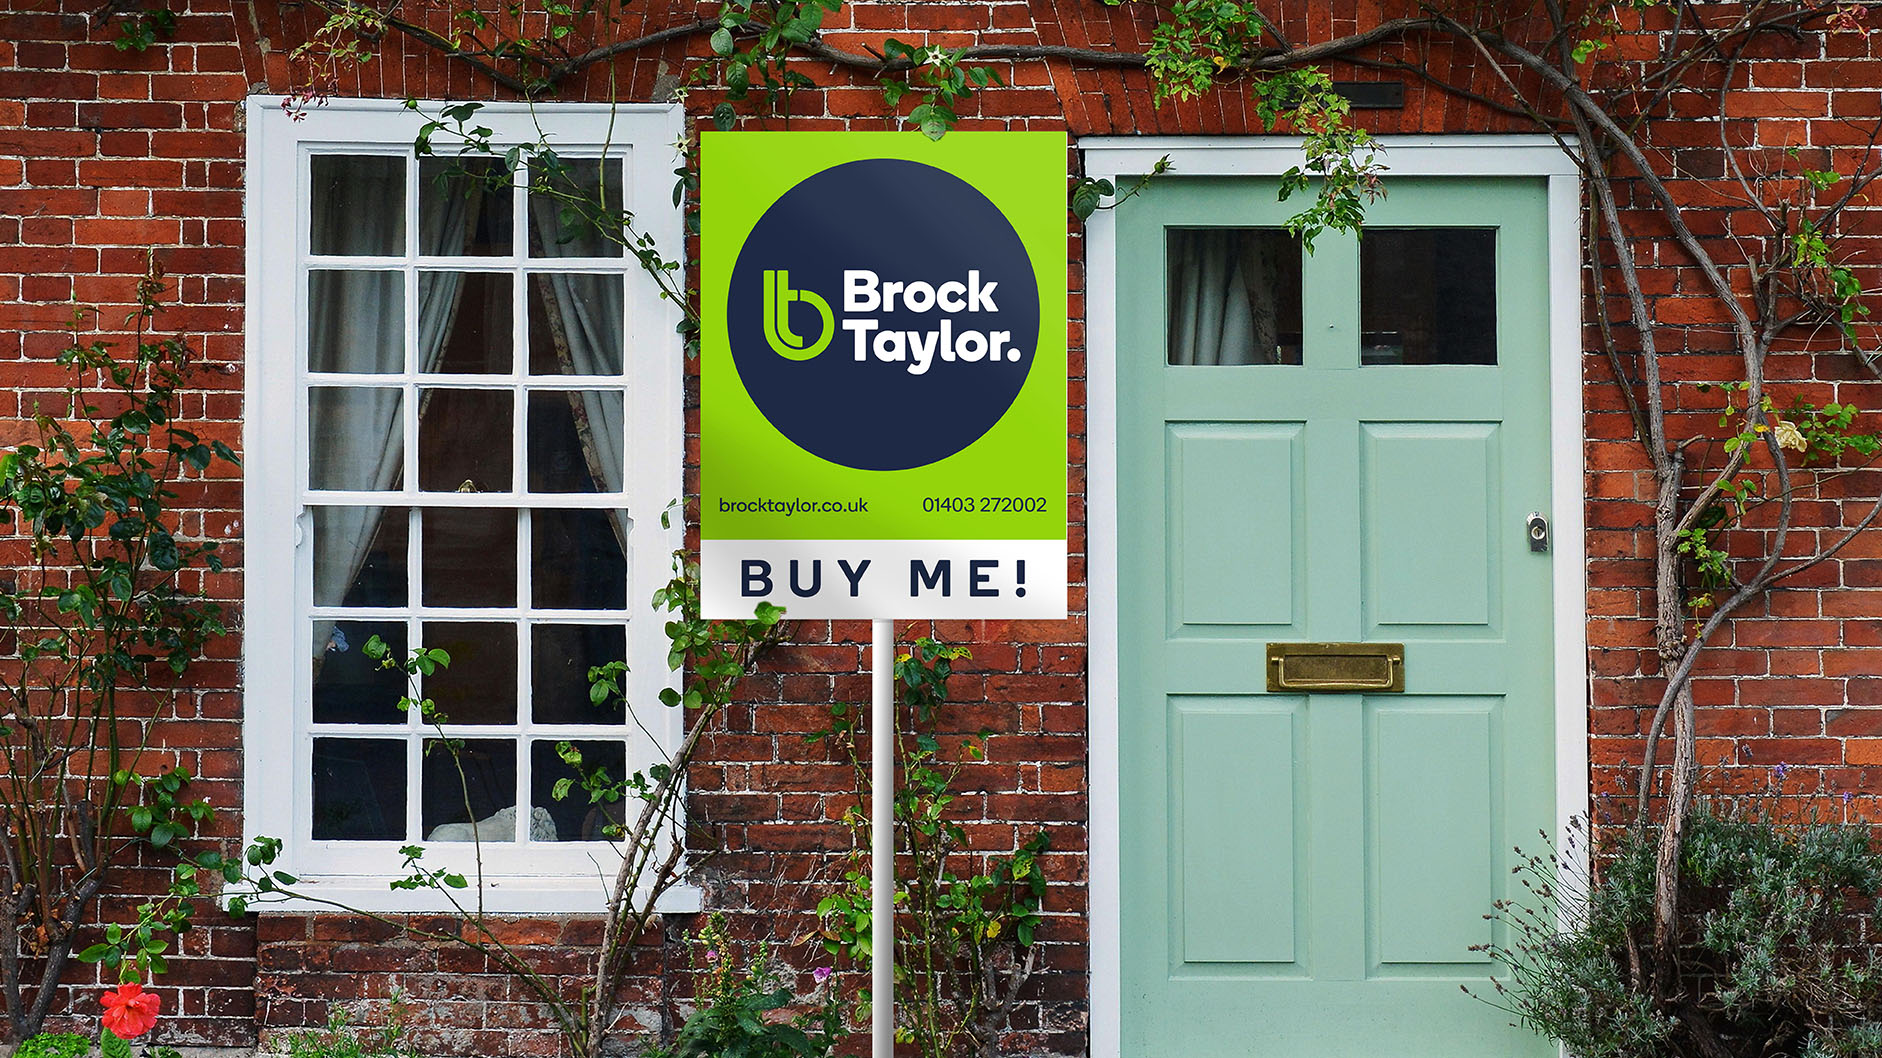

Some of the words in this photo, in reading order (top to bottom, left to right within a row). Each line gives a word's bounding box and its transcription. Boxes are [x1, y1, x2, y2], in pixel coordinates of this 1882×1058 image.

[843, 269, 998, 313] Brock
[842, 318, 1021, 375] Taylor.
[719, 497, 869, 517] brocktaylor.co.uk
[922, 497, 975, 513] 01403
[979, 497, 1047, 513] 272002
[741, 559, 872, 598] BUY
[910, 559, 1027, 598] ME!
